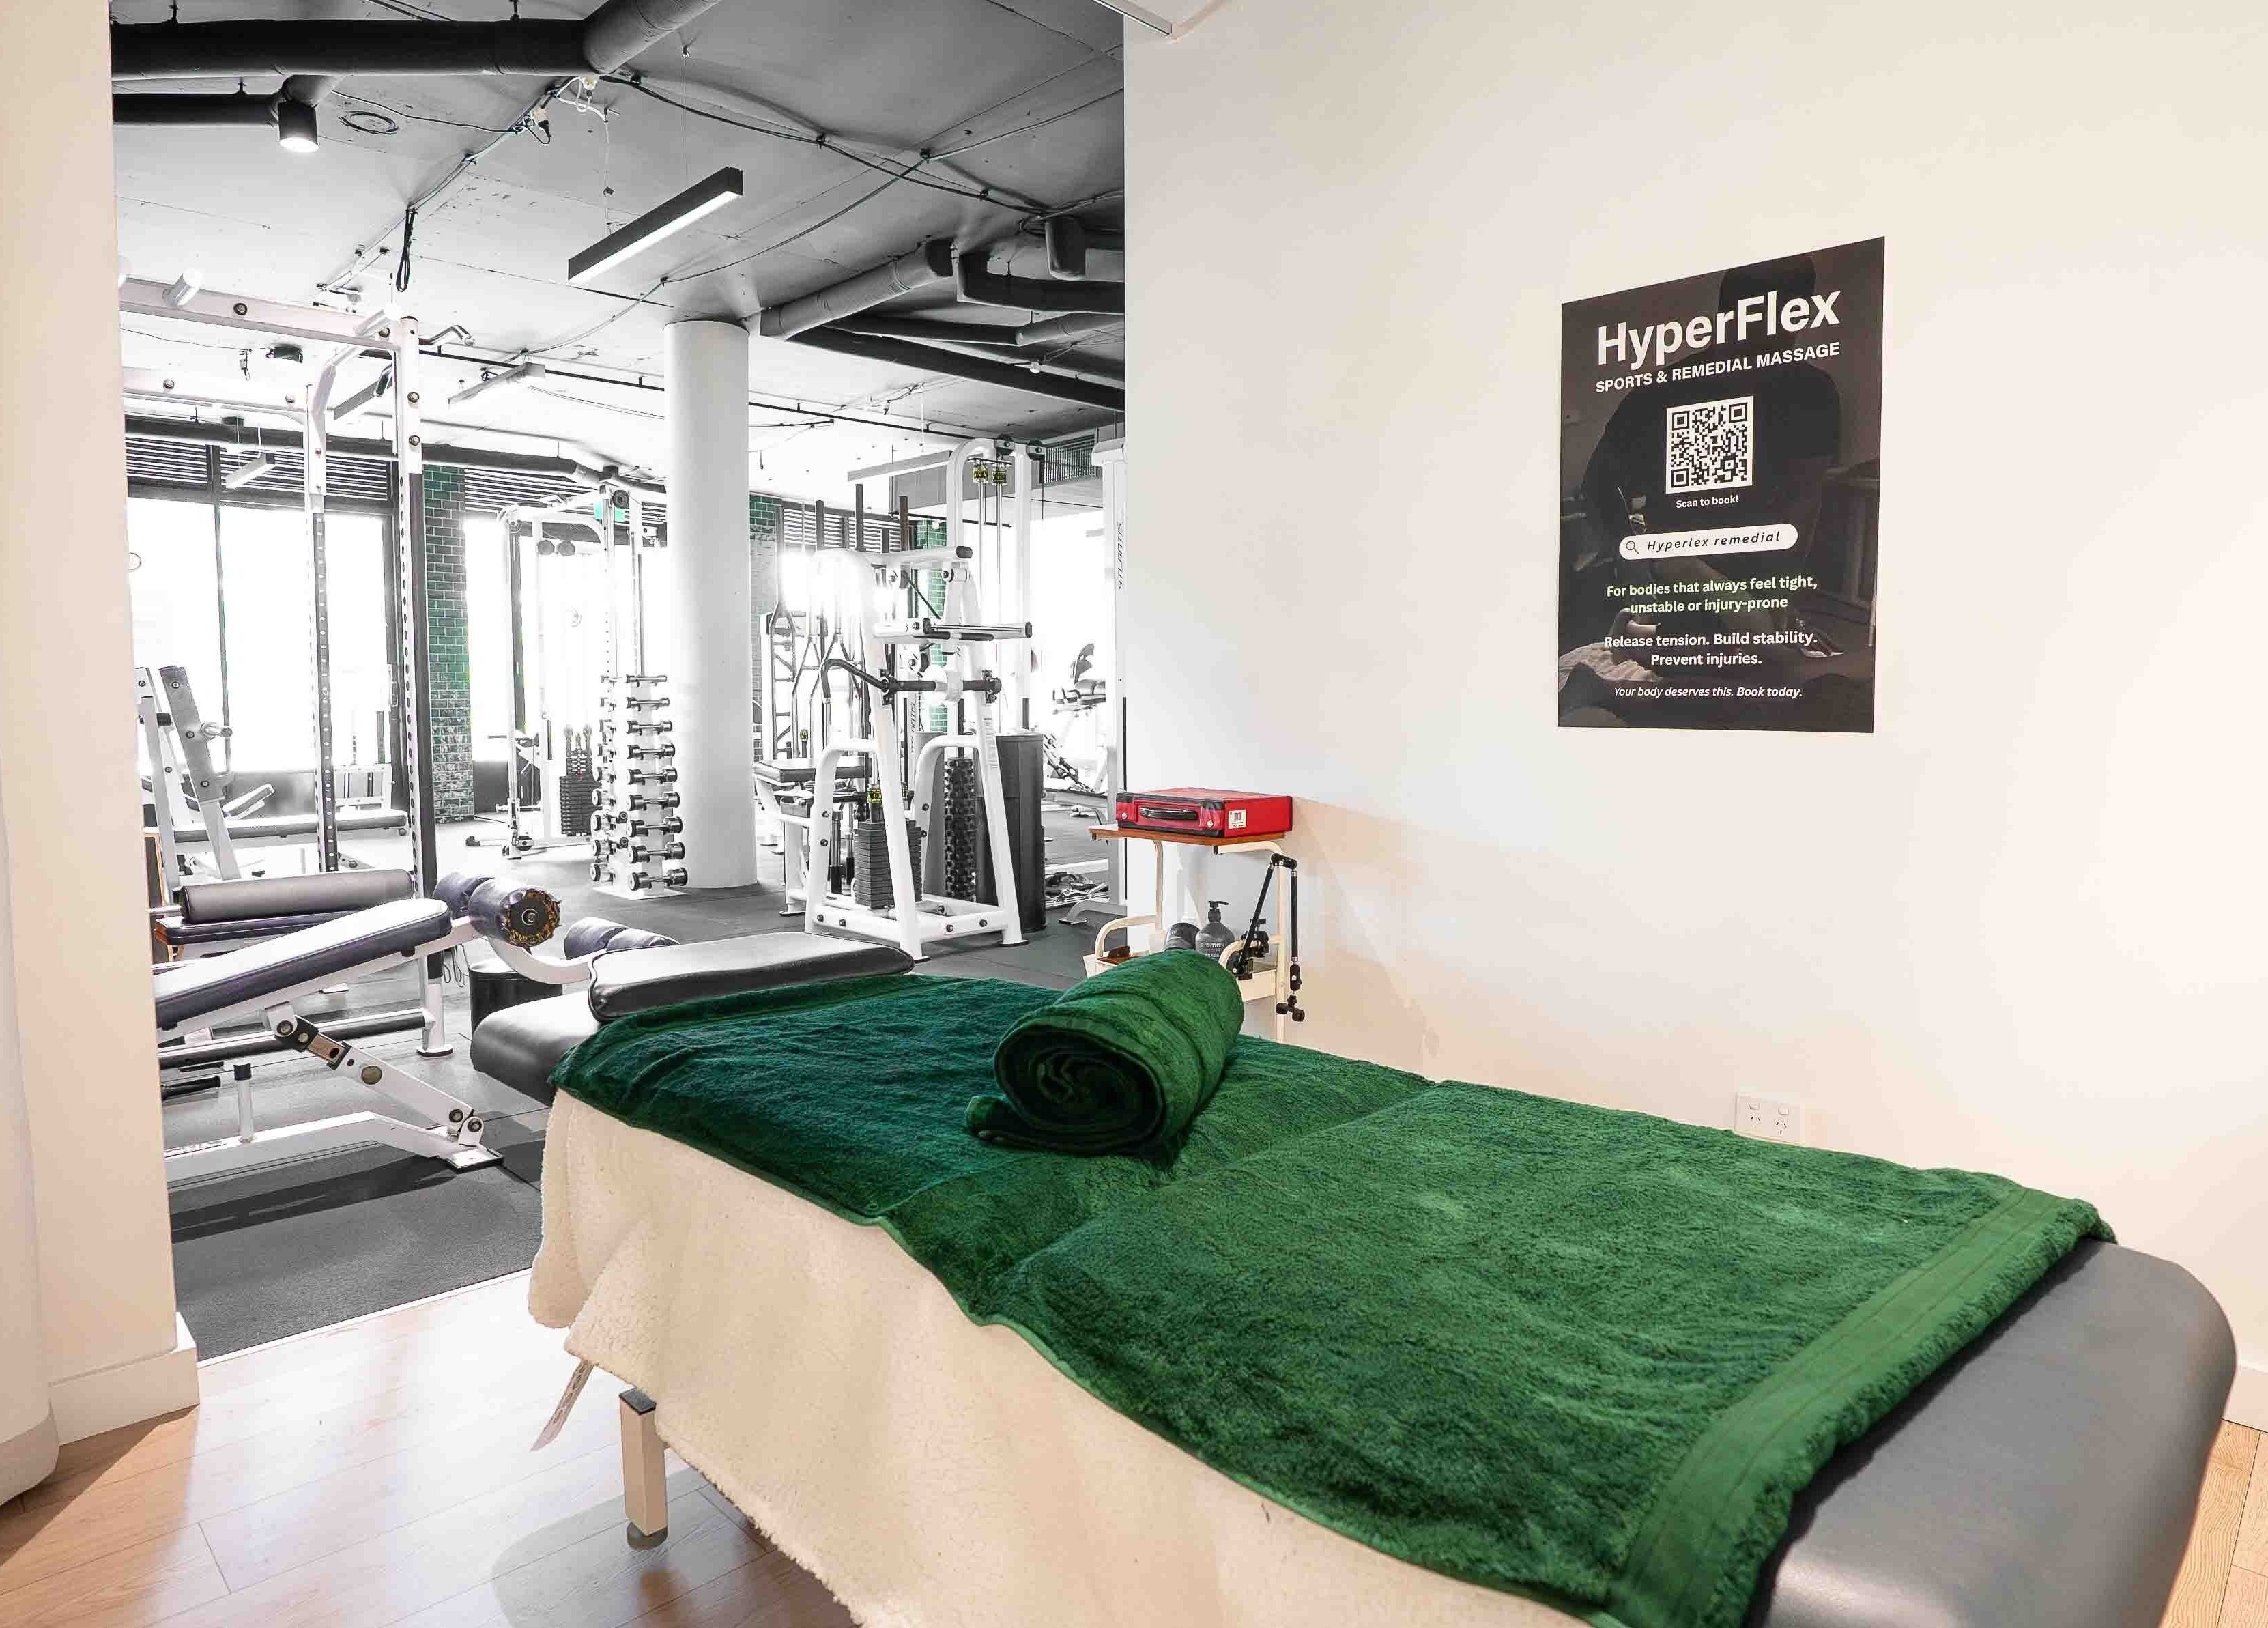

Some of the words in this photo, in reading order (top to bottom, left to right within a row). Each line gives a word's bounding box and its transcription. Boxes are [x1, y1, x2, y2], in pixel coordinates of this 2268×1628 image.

[1598, 291, 1841, 370] HyperFlex
[1596, 372, 1652, 393] SPORTS
[1656, 371, 1668, 384] &
[1671, 357, 1753, 382] REMEDIAL
[1756, 342, 1840, 368] MASSAGE
[1676, 499, 1698, 509] Scan
[1700, 498, 1710, 506] to
[1712, 494, 1739, 505] book!
[1647, 539, 1708, 552] Hyperlex
[1714, 531, 1780, 546] remedial
[1607, 585, 1626, 597] For
[1629, 585, 1670, 595] bodies
[1673, 584, 1700, 594] that
[1702, 579, 1747, 595] always
[1750, 577, 1776, 590] feel
[1779, 575, 1818, 592] tight,
[1631, 601, 1684, 614] unstable
[1687, 601, 1702, 611] or
[1704, 597, 1788, 614] injury-prone
[1604, 636, 1653, 648] Release
[1656, 635, 1709, 646] tension.
[1713, 632, 1750, 645] Build
[1753, 631, 1818, 647] stability.
[1651, 653, 1703, 666] Prevent
[1706, 651, 1762, 668] injuries.
[1613, 687, 1636, 696] Your
[1637, 686, 1663, 698] body
[1665, 687, 1710, 696] deserves
[1712, 687, 1734, 696] this.
[1736, 686, 1764, 697] Book
[1766, 687, 1803, 699] today.
